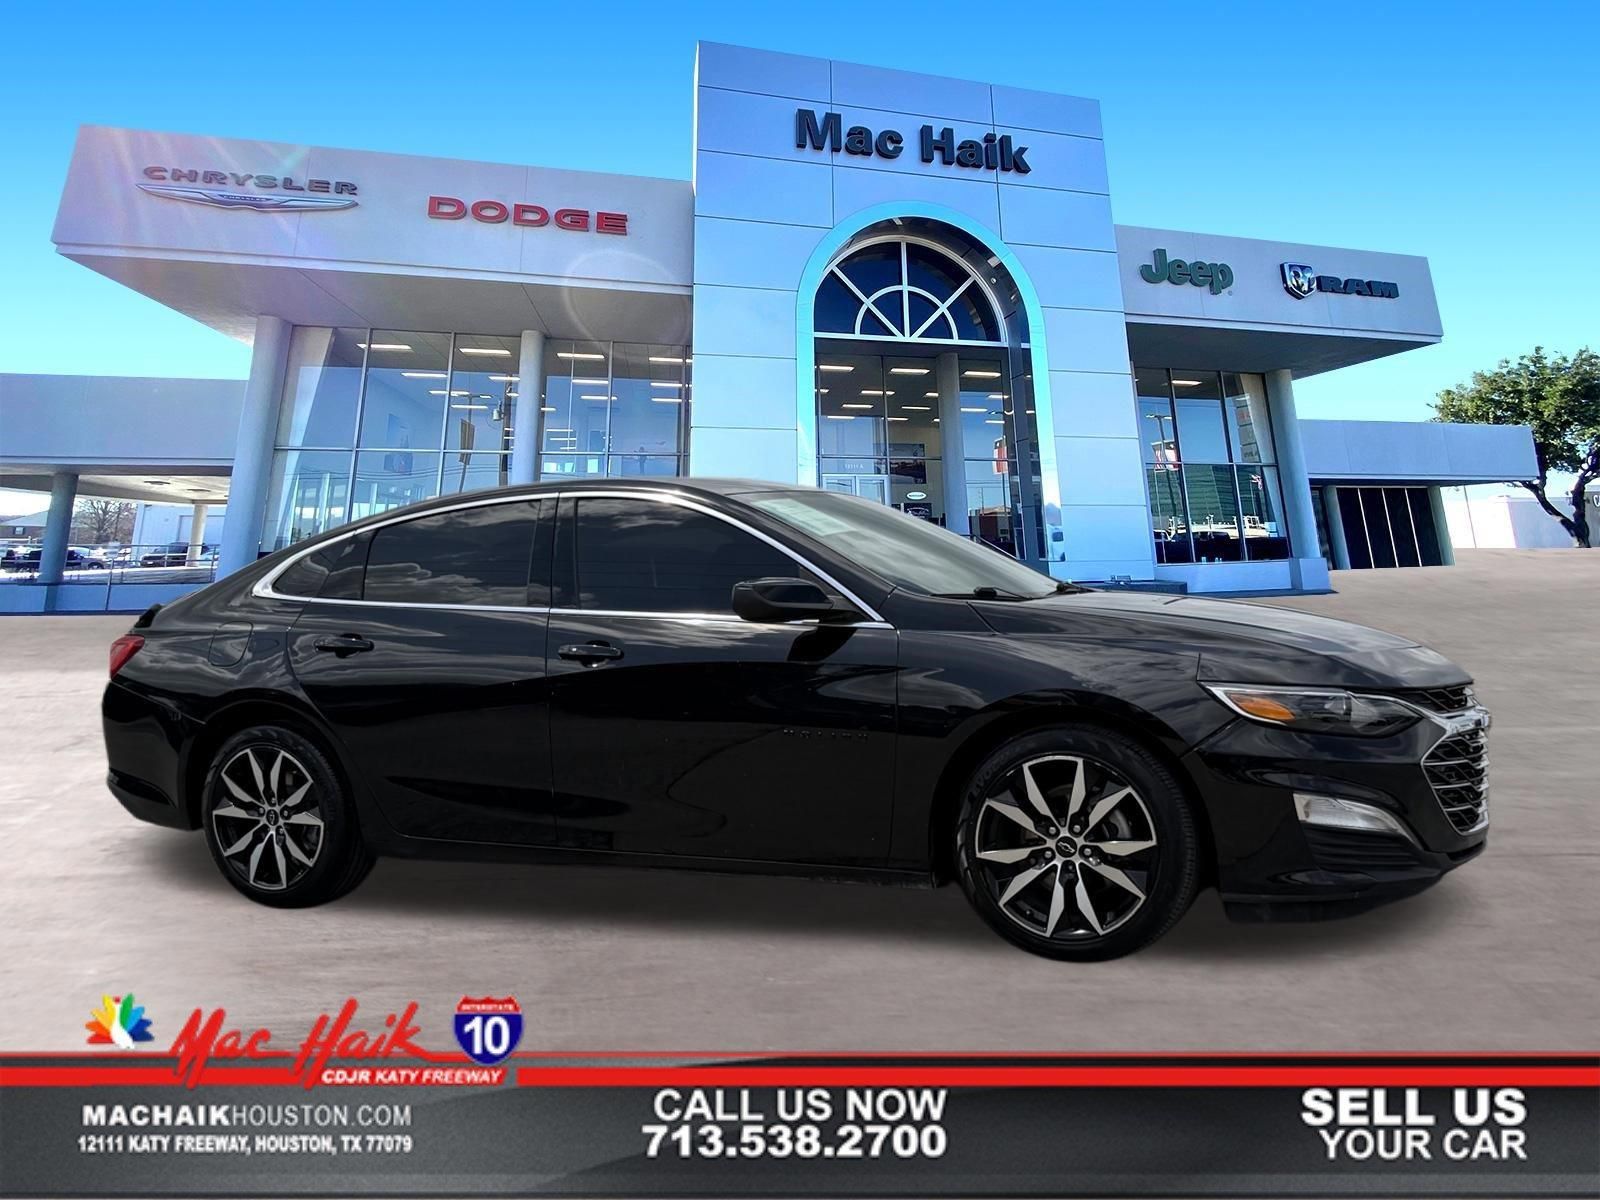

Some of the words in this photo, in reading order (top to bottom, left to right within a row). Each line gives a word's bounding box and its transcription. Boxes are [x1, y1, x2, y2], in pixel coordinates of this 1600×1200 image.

[796, 108, 904, 160] Mac
[920, 124, 1031, 174] Haik
[143, 165, 359, 196] CHRYSLER
[428, 195, 628, 235] DODGE
[1139, 248, 1234, 295] Jeep
[1315, 275, 1400, 299] RAM
